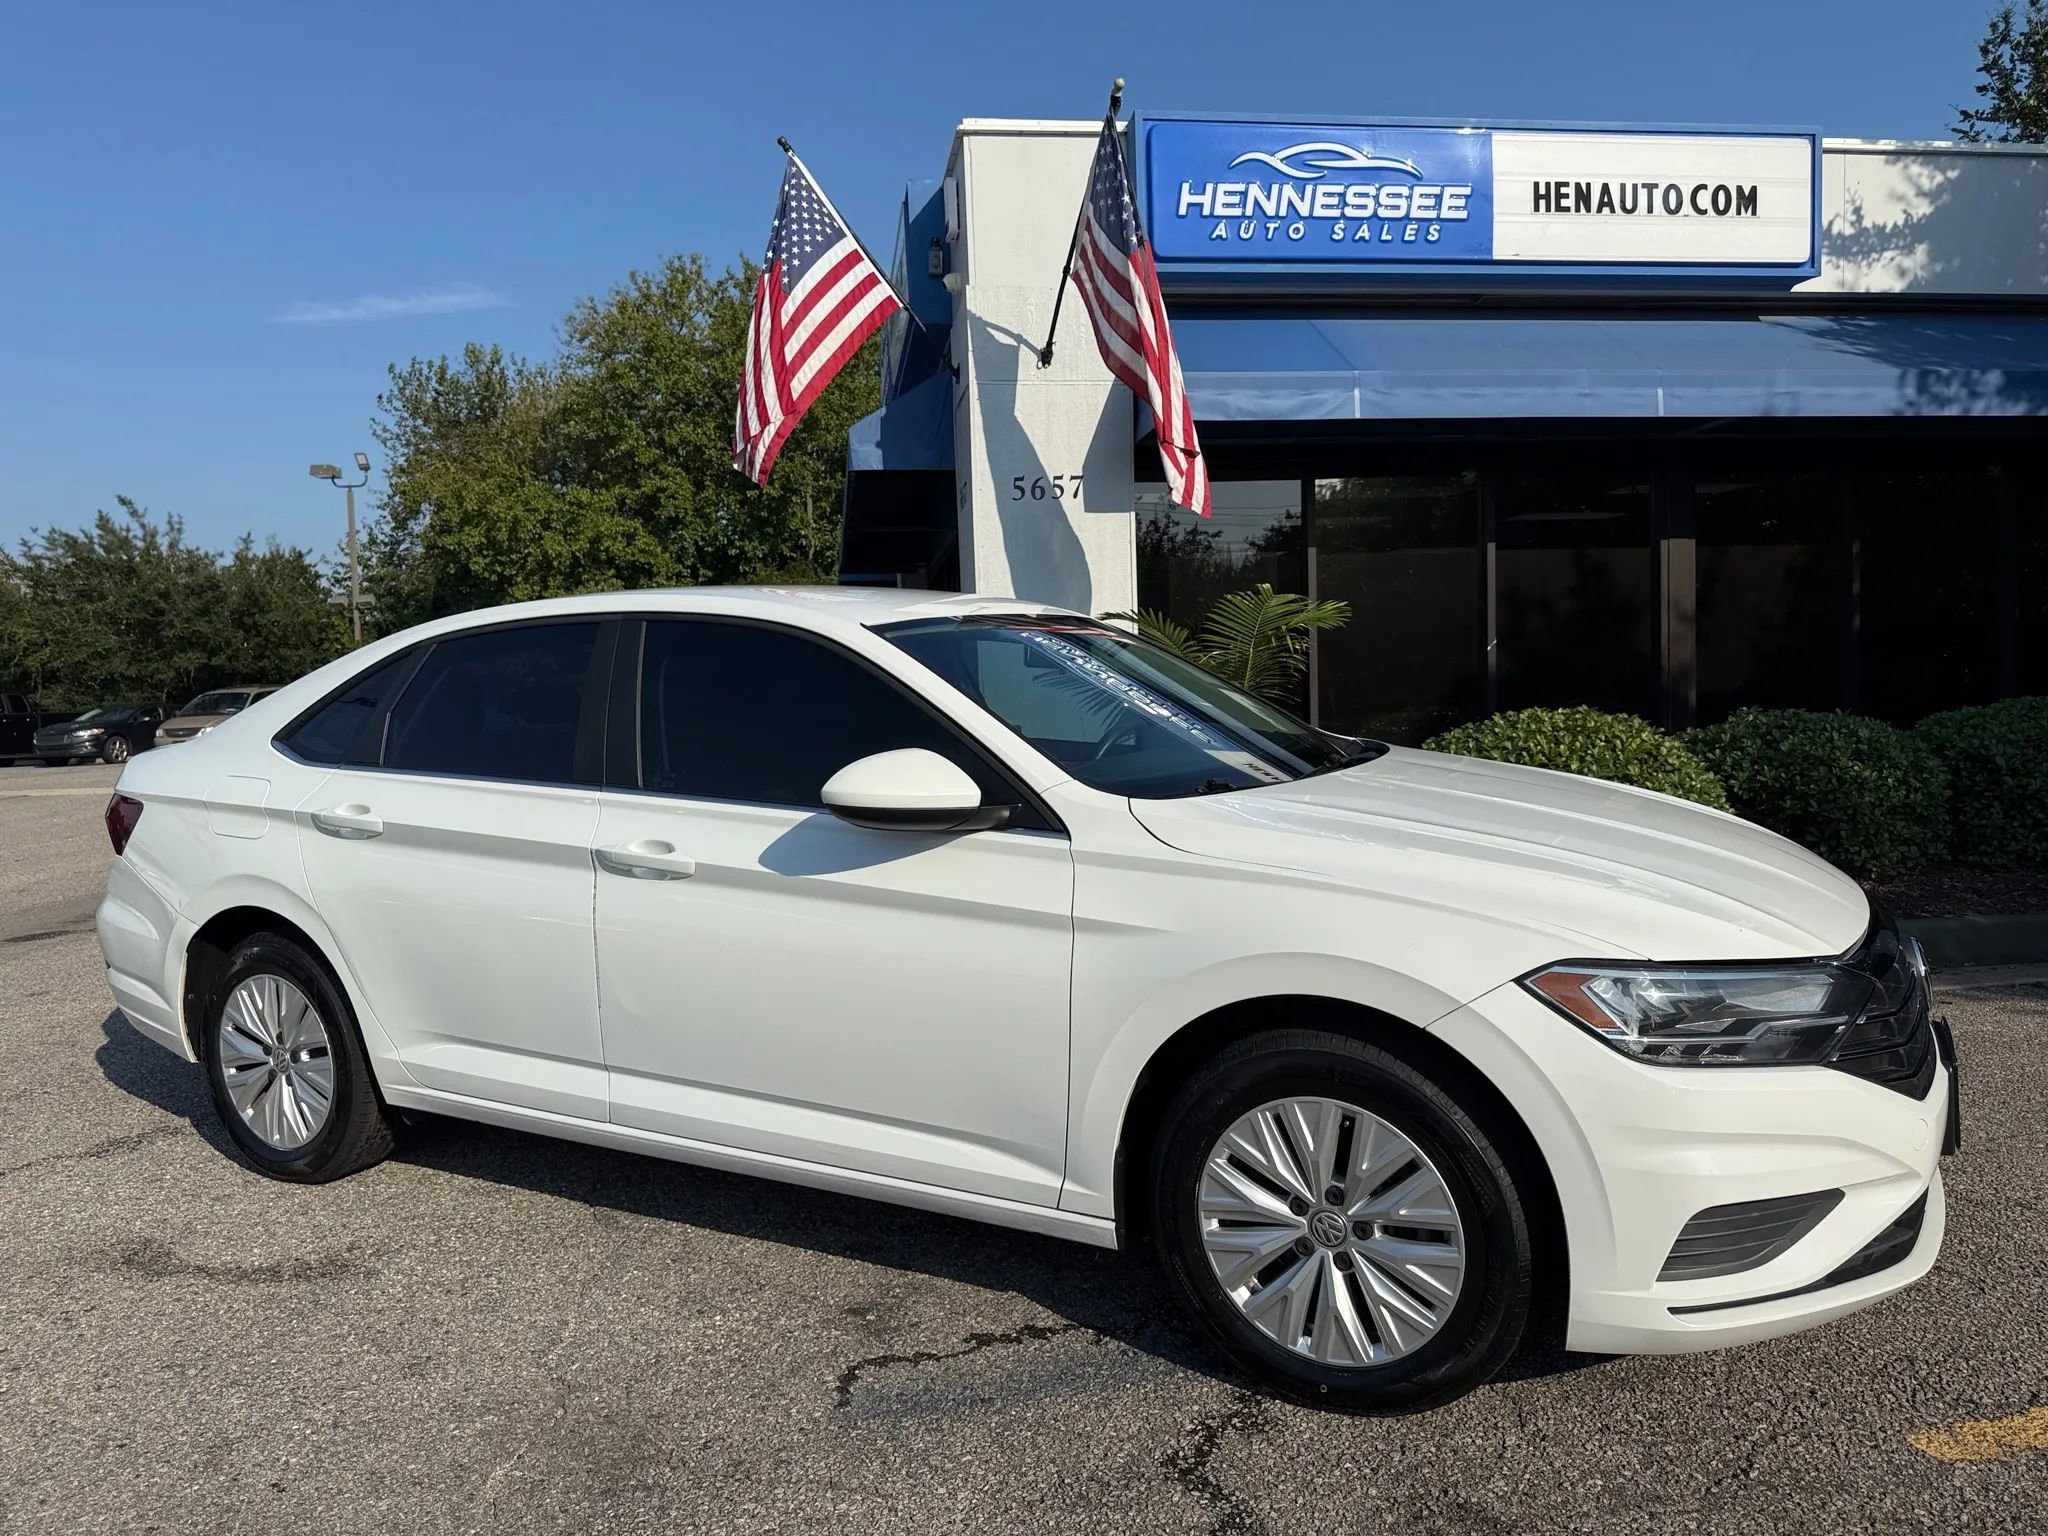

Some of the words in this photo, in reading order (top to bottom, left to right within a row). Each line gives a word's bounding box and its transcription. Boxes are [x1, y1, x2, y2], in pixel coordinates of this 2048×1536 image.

[1177, 182, 1472, 219] HENNESSEE
[1210, 221, 1305, 240] AUTO
[1331, 222, 1442, 242] SALES
[1011, 474, 1085, 501] 5657
